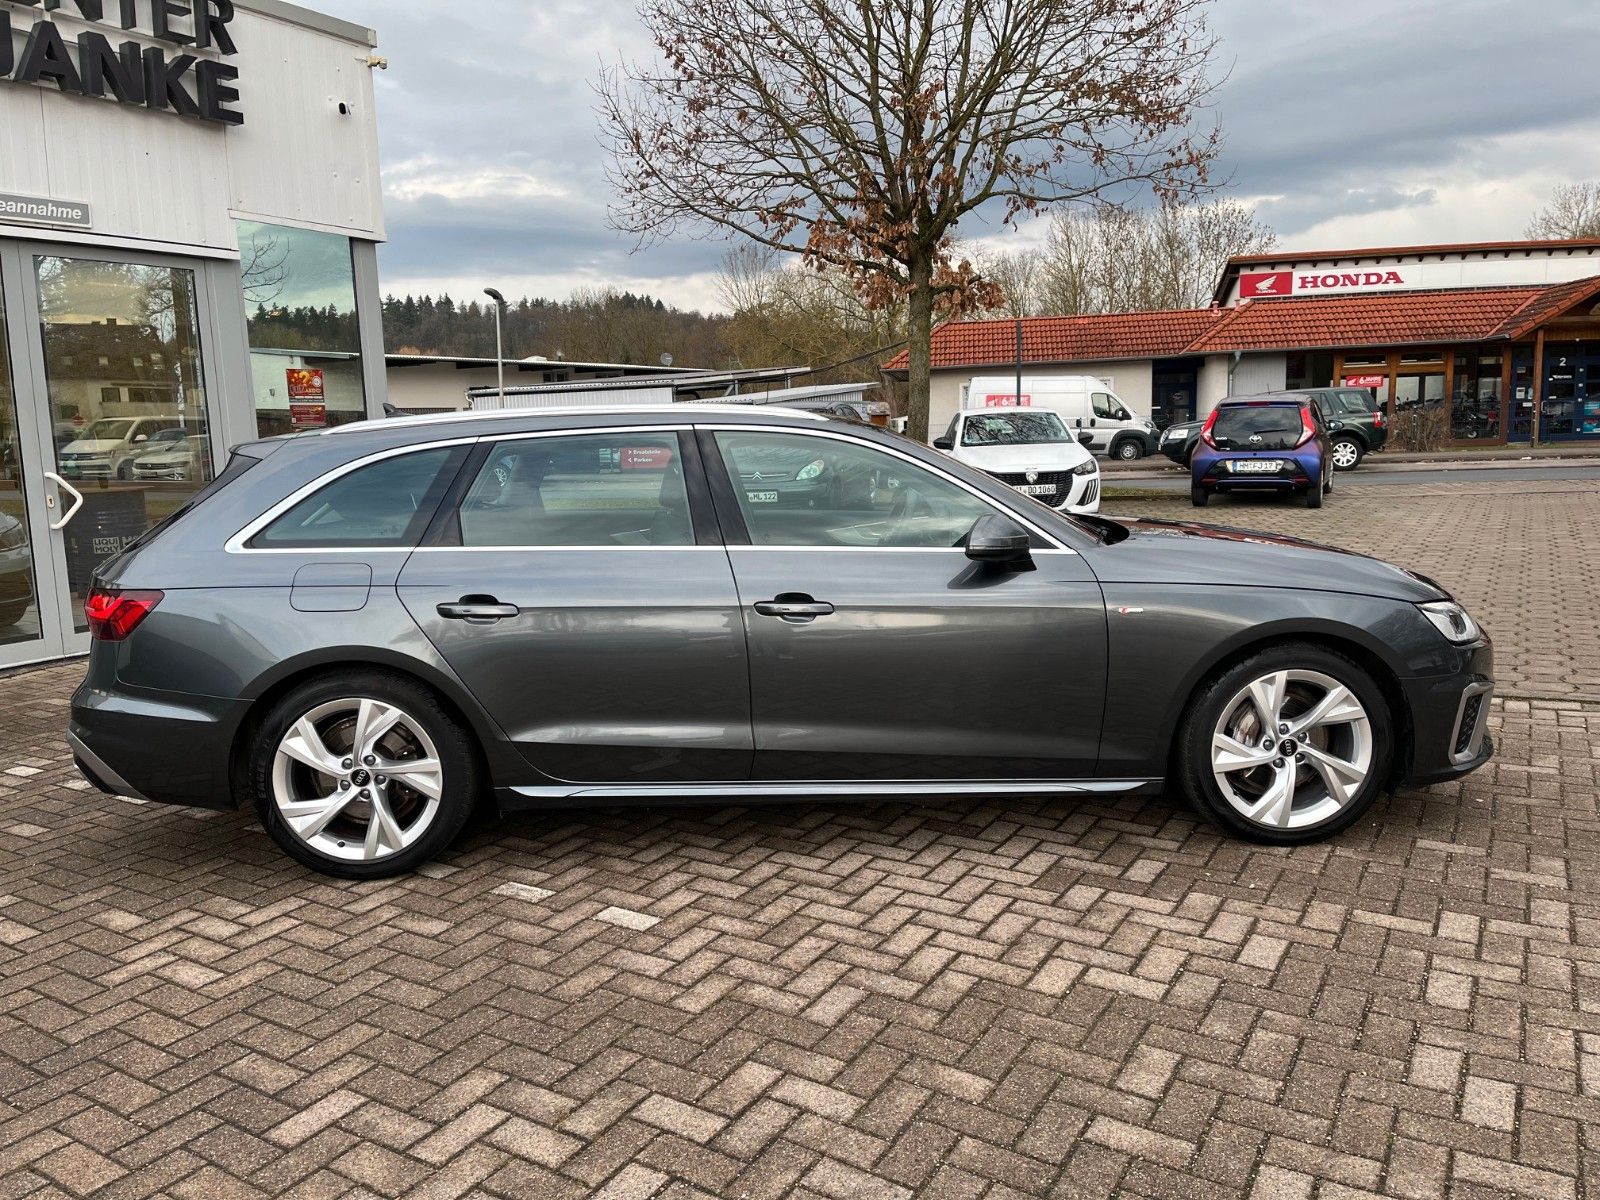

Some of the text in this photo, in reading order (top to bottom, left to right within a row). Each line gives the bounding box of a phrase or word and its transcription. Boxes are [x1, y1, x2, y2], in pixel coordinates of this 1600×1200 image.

[0, 200, 82, 219] eannahme
[1298, 271, 1404, 289] HONDA
[1559, 357, 1567, 367] 2
[1359, 376, 1365, 385] 6
[1002, 397, 1008, 406] 6
[763, 492, 776, 500] 122
[94, 538, 118, 546] LIQUI
[95, 545, 119, 553] MOLY
